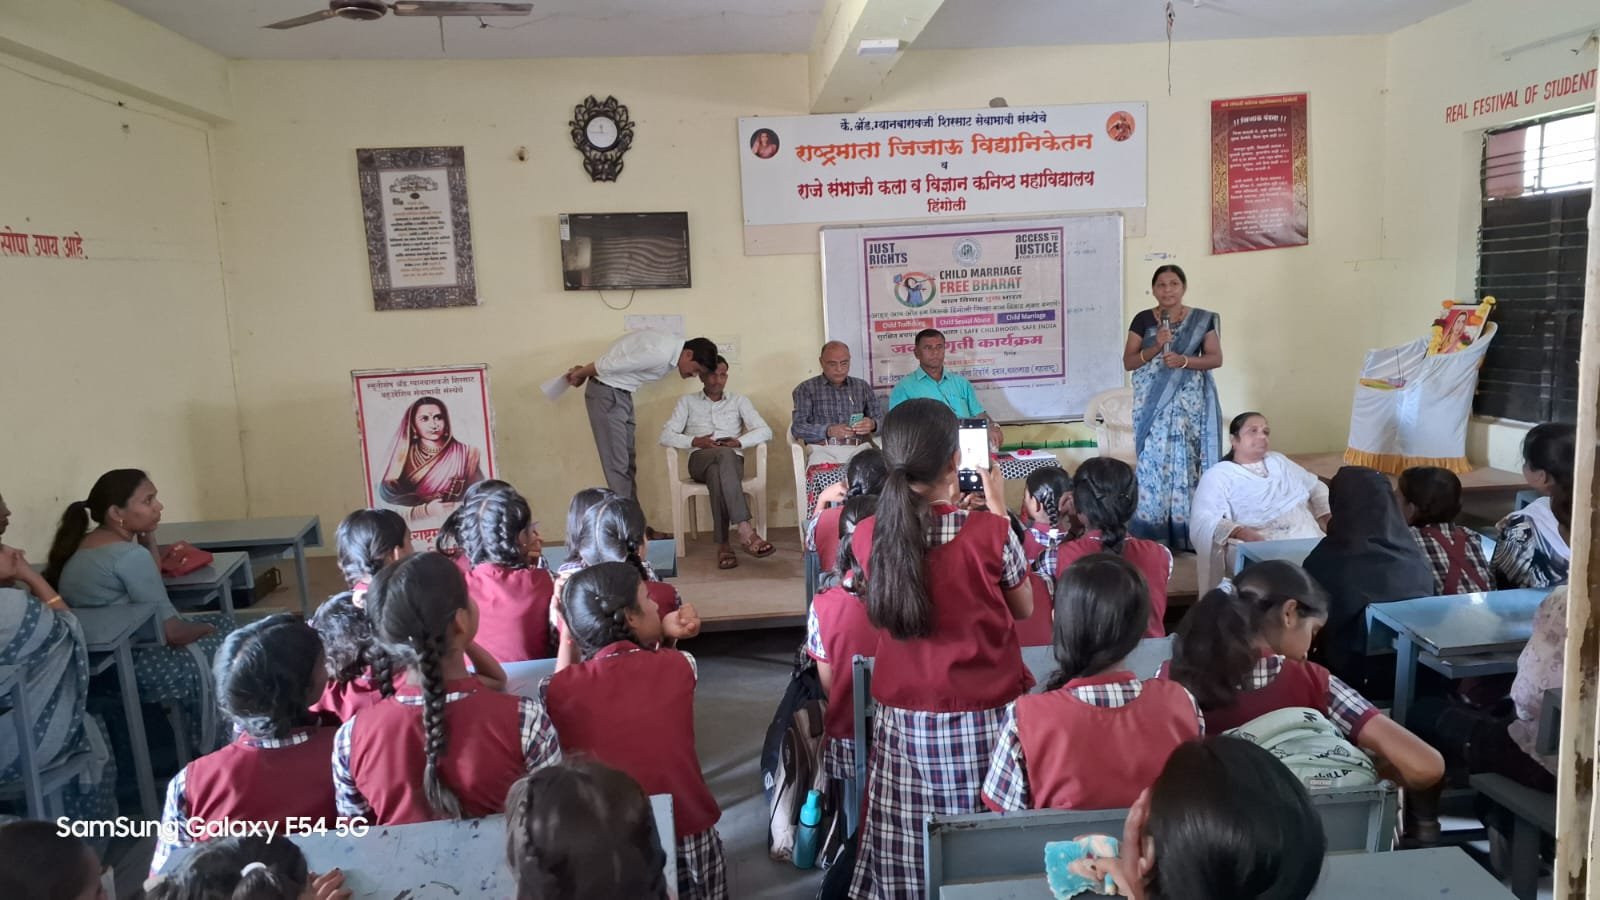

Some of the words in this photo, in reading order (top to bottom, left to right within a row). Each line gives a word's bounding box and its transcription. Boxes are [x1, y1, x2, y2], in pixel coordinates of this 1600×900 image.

[1446, 102, 1468, 123] REAL
[1473, 90, 1518, 116] FESTIVAL
[1525, 84, 1539, 104] OF
[975, 112, 1014, 126] सेवाभावी
[1017, 110, 1047, 124] संस्थेचे
[794, 142, 881, 166] राष्ट्रमाता
[887, 136, 963, 158] जिजाऊ
[971, 130, 1093, 154] विद्यानिकेतन
[941, 161, 948, 169] व
[797, 178, 823, 200] राजे
[827, 176, 874, 198] संभाजी
[877, 179, 907, 195] कला
[911, 177, 921, 194] व
[926, 173, 968, 192] विज्ञान
[973, 171, 1016, 190] कनिष्ठ
[1020, 168, 1095, 188] महाविद्यालय
[927, 197, 966, 213] हिंगोली
[869, 243, 895, 254] JUST
[1015, 242, 1059, 259] JUSTICE
[869, 253, 908, 265] RIGHTS
[940, 269, 968, 280] CHILD
[970, 266, 1023, 278] MARRIAGE
[940, 280, 969, 293] FREE
[972, 277, 1023, 292] BHARAT
[1006, 313, 1021, 321] Child
[1021, 311, 1046, 320] Marriage
[882, 321, 897, 329] Child
[977, 333, 1044, 348] कार्यक्रम
